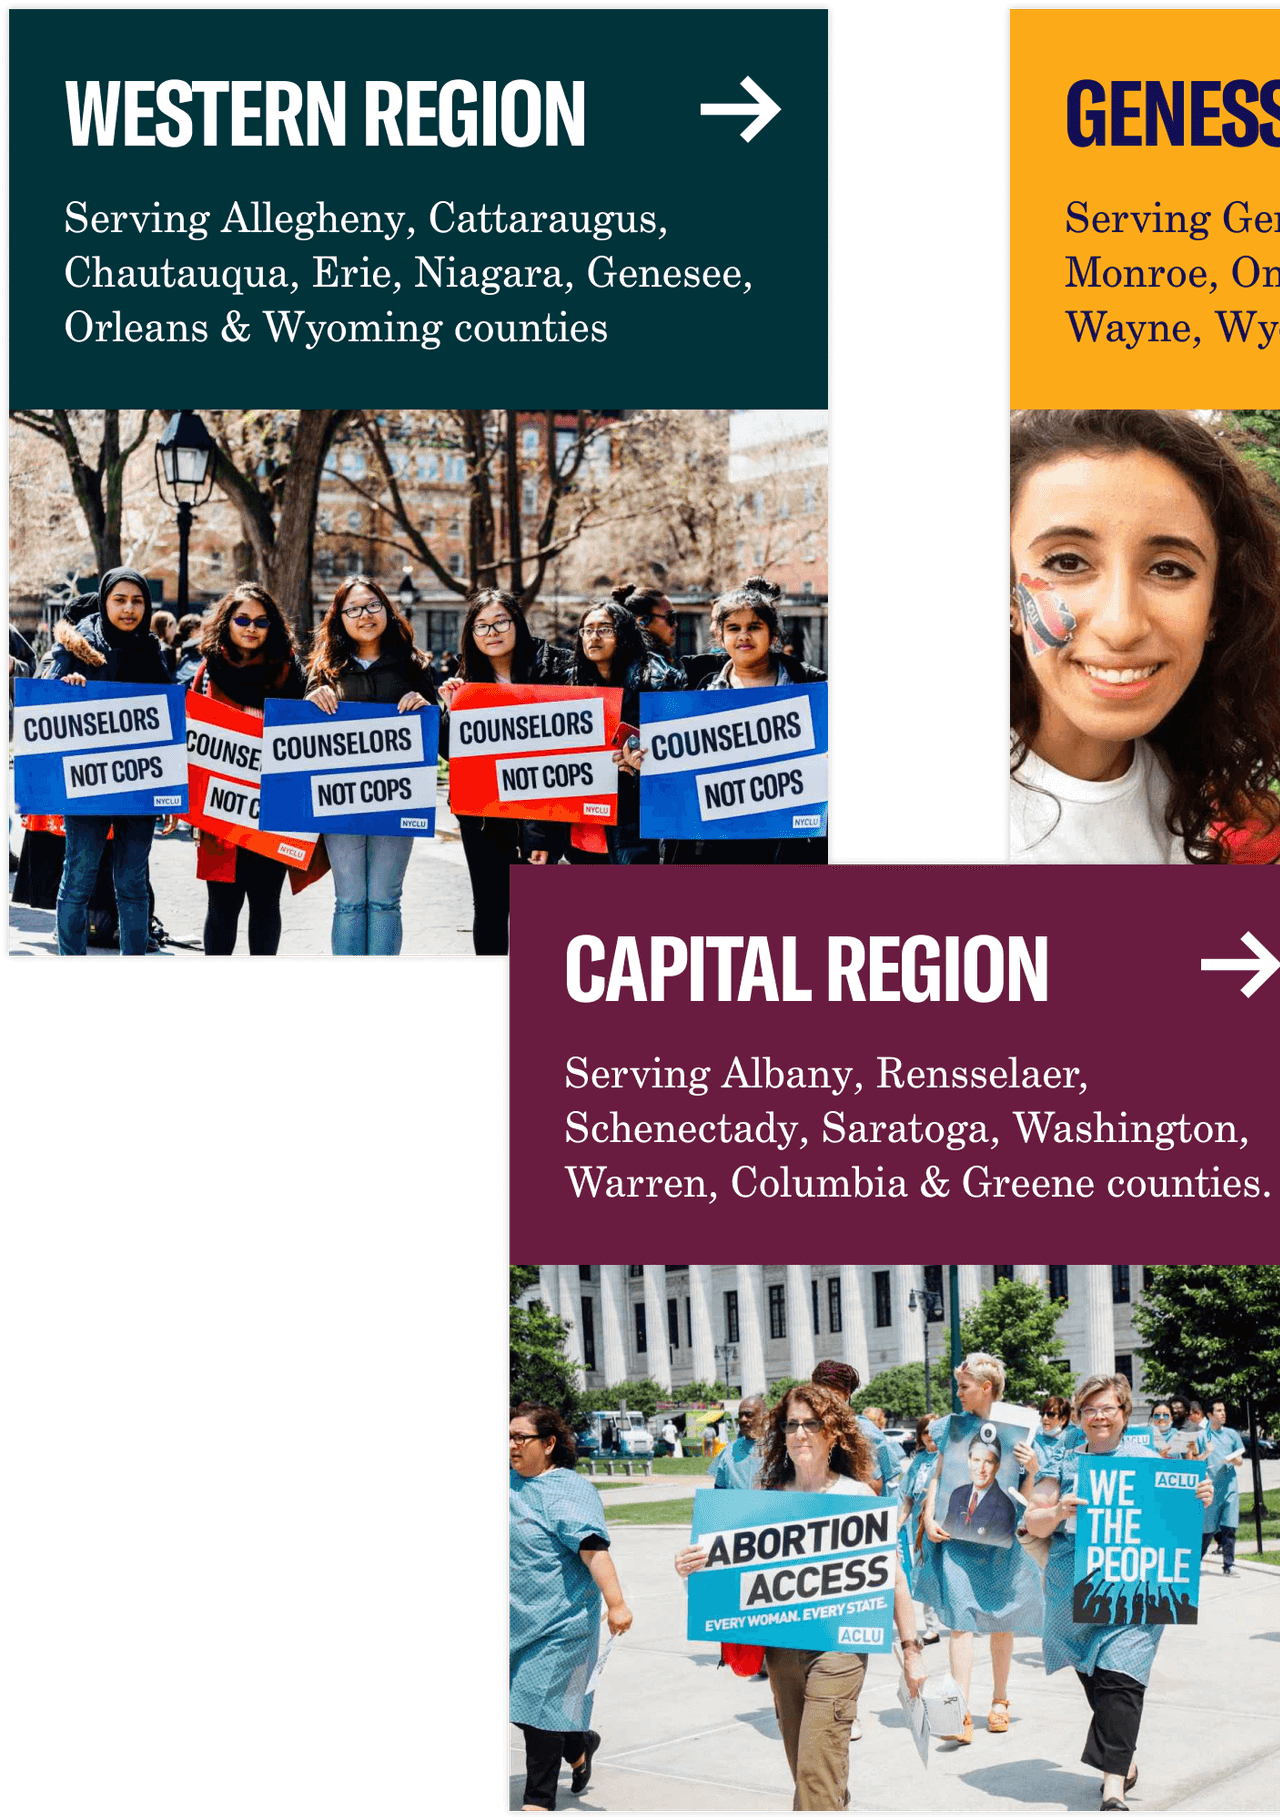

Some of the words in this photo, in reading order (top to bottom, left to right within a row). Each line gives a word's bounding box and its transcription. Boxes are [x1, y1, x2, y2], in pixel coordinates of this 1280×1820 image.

[24, 706, 160, 742] COUNSELORS
[459, 710, 593, 744] COUNSELORS
[651, 711, 802, 761] COUNSELORS
[186, 730, 262, 772] COUNSE
[272, 727, 411, 761] COUNSELORS
[70, 762, 110, 788] NOT
[112, 756, 163, 784] COPS
[502, 765, 540, 791] NOT
[543, 762, 593, 788] COPS
[704, 781, 747, 809] NOT
[750, 769, 804, 802] COPS
[156, 796, 180, 806] NYCLU
[211, 787, 247, 815] NOT
[318, 782, 358, 807] NOT
[361, 777, 412, 803] COPS
[402, 818, 427, 829] NYCLU
[585, 805, 609, 815] NYCLU
[794, 817, 819, 827] NYCLU
[278, 843, 304, 860] NYCLU
[1090, 1470, 1136, 1506] WE
[1158, 1474, 1196, 1488] ACLU
[705, 1510, 888, 1568] ABORTION
[1087, 1508, 1142, 1544] THE
[746, 1555, 889, 1606] ACCESS
[1087, 1546, 1192, 1583] PEOPLE
[705, 1616, 746, 1632] EVERY
[747, 1610, 800, 1627] WOMAN.
[803, 1604, 845, 1621] EVERY
[847, 1597, 888, 1614] STATE.
[841, 1629, 881, 1642] ACLU
